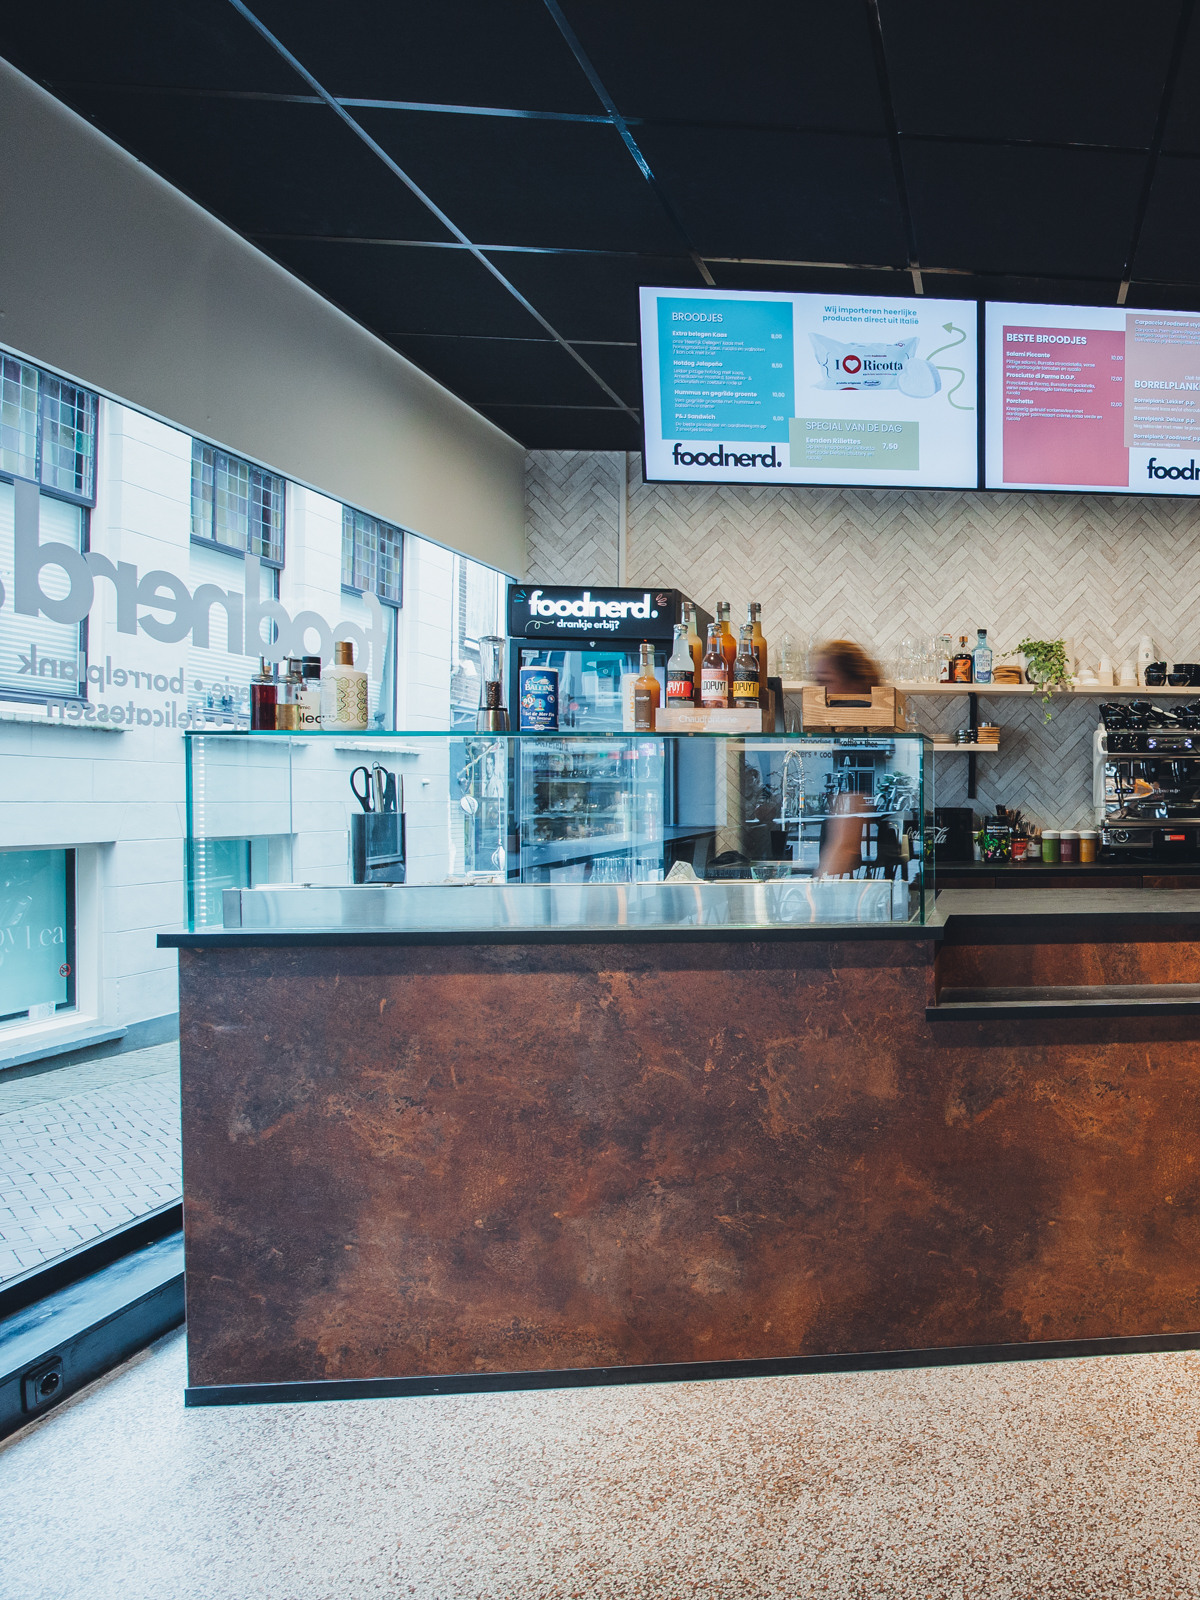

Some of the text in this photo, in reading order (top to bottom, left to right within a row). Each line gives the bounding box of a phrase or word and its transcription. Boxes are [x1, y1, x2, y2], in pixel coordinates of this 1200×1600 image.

[672, 312, 723, 322] BROODJES
[825, 306, 917, 317] Wij importeren heerlijke
[823, 315, 862, 323] producten
[1007, 333, 1087, 344] BESTE BROODJES
[864, 360, 903, 371] Ricotta
[806, 422, 842, 431] SPECIAL
[845, 423, 865, 431] VAN
[882, 424, 902, 433] DAG
[672, 443, 782, 468] foodnerd.
[529, 590, 658, 619] foodnerd.
[557, 619, 619, 631] drankje erbij?
[678, 715, 738, 724] Chaudfontaine
